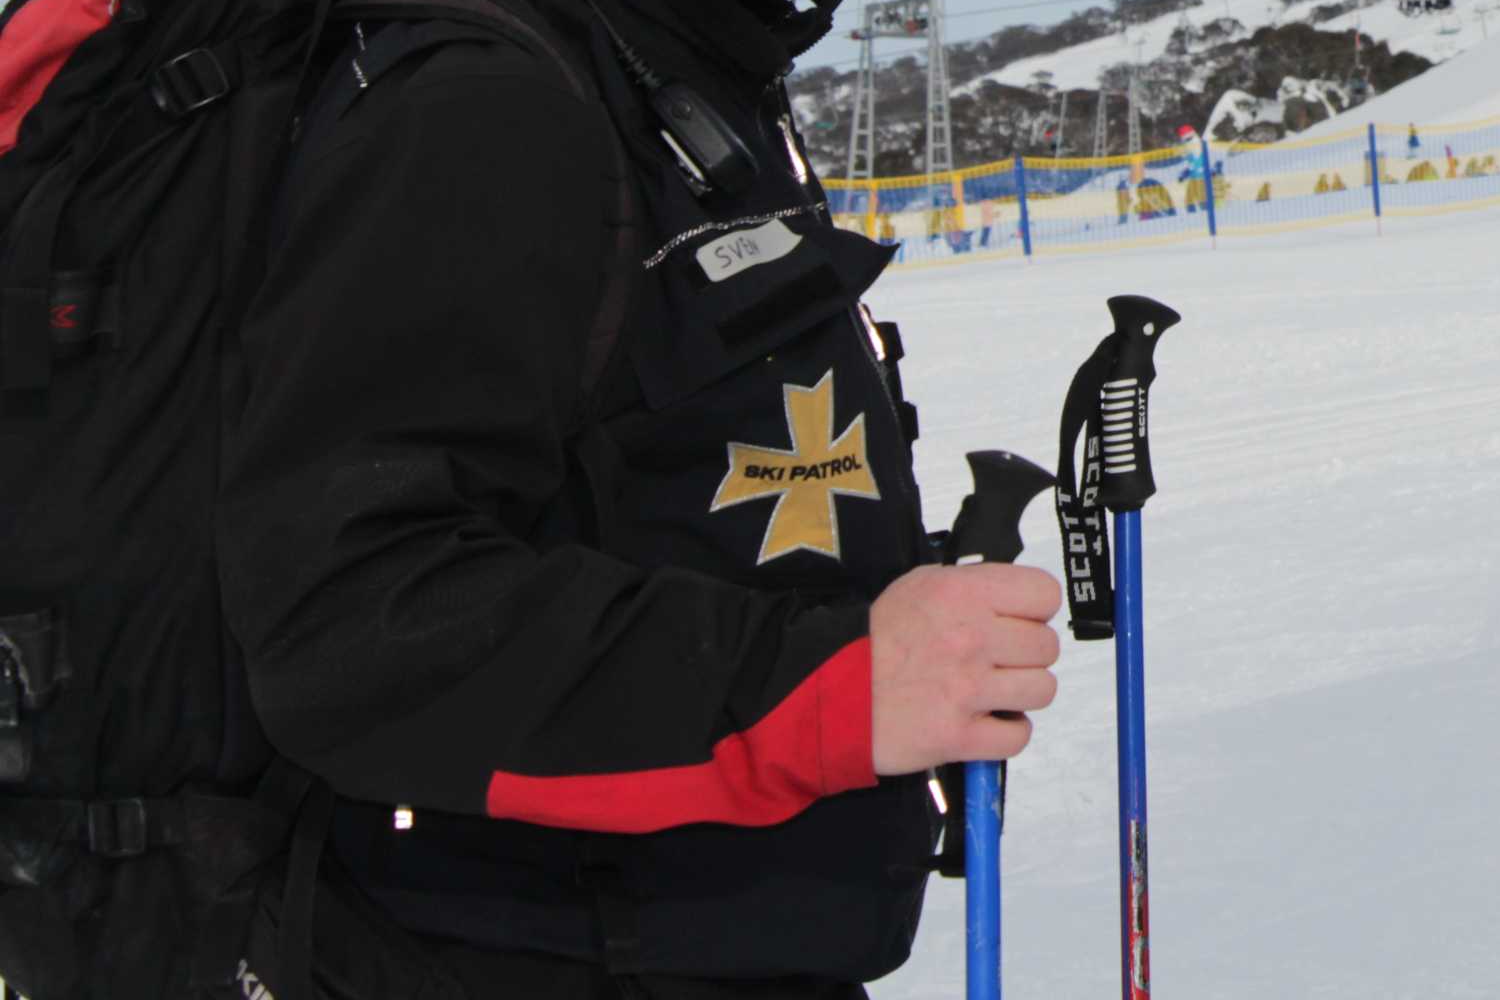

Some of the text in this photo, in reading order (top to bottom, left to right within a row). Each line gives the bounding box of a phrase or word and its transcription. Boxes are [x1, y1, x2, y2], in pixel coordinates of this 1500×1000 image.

[744, 453, 863, 481] SKI PATROL
[1057, 487, 1096, 603] SCOTT
